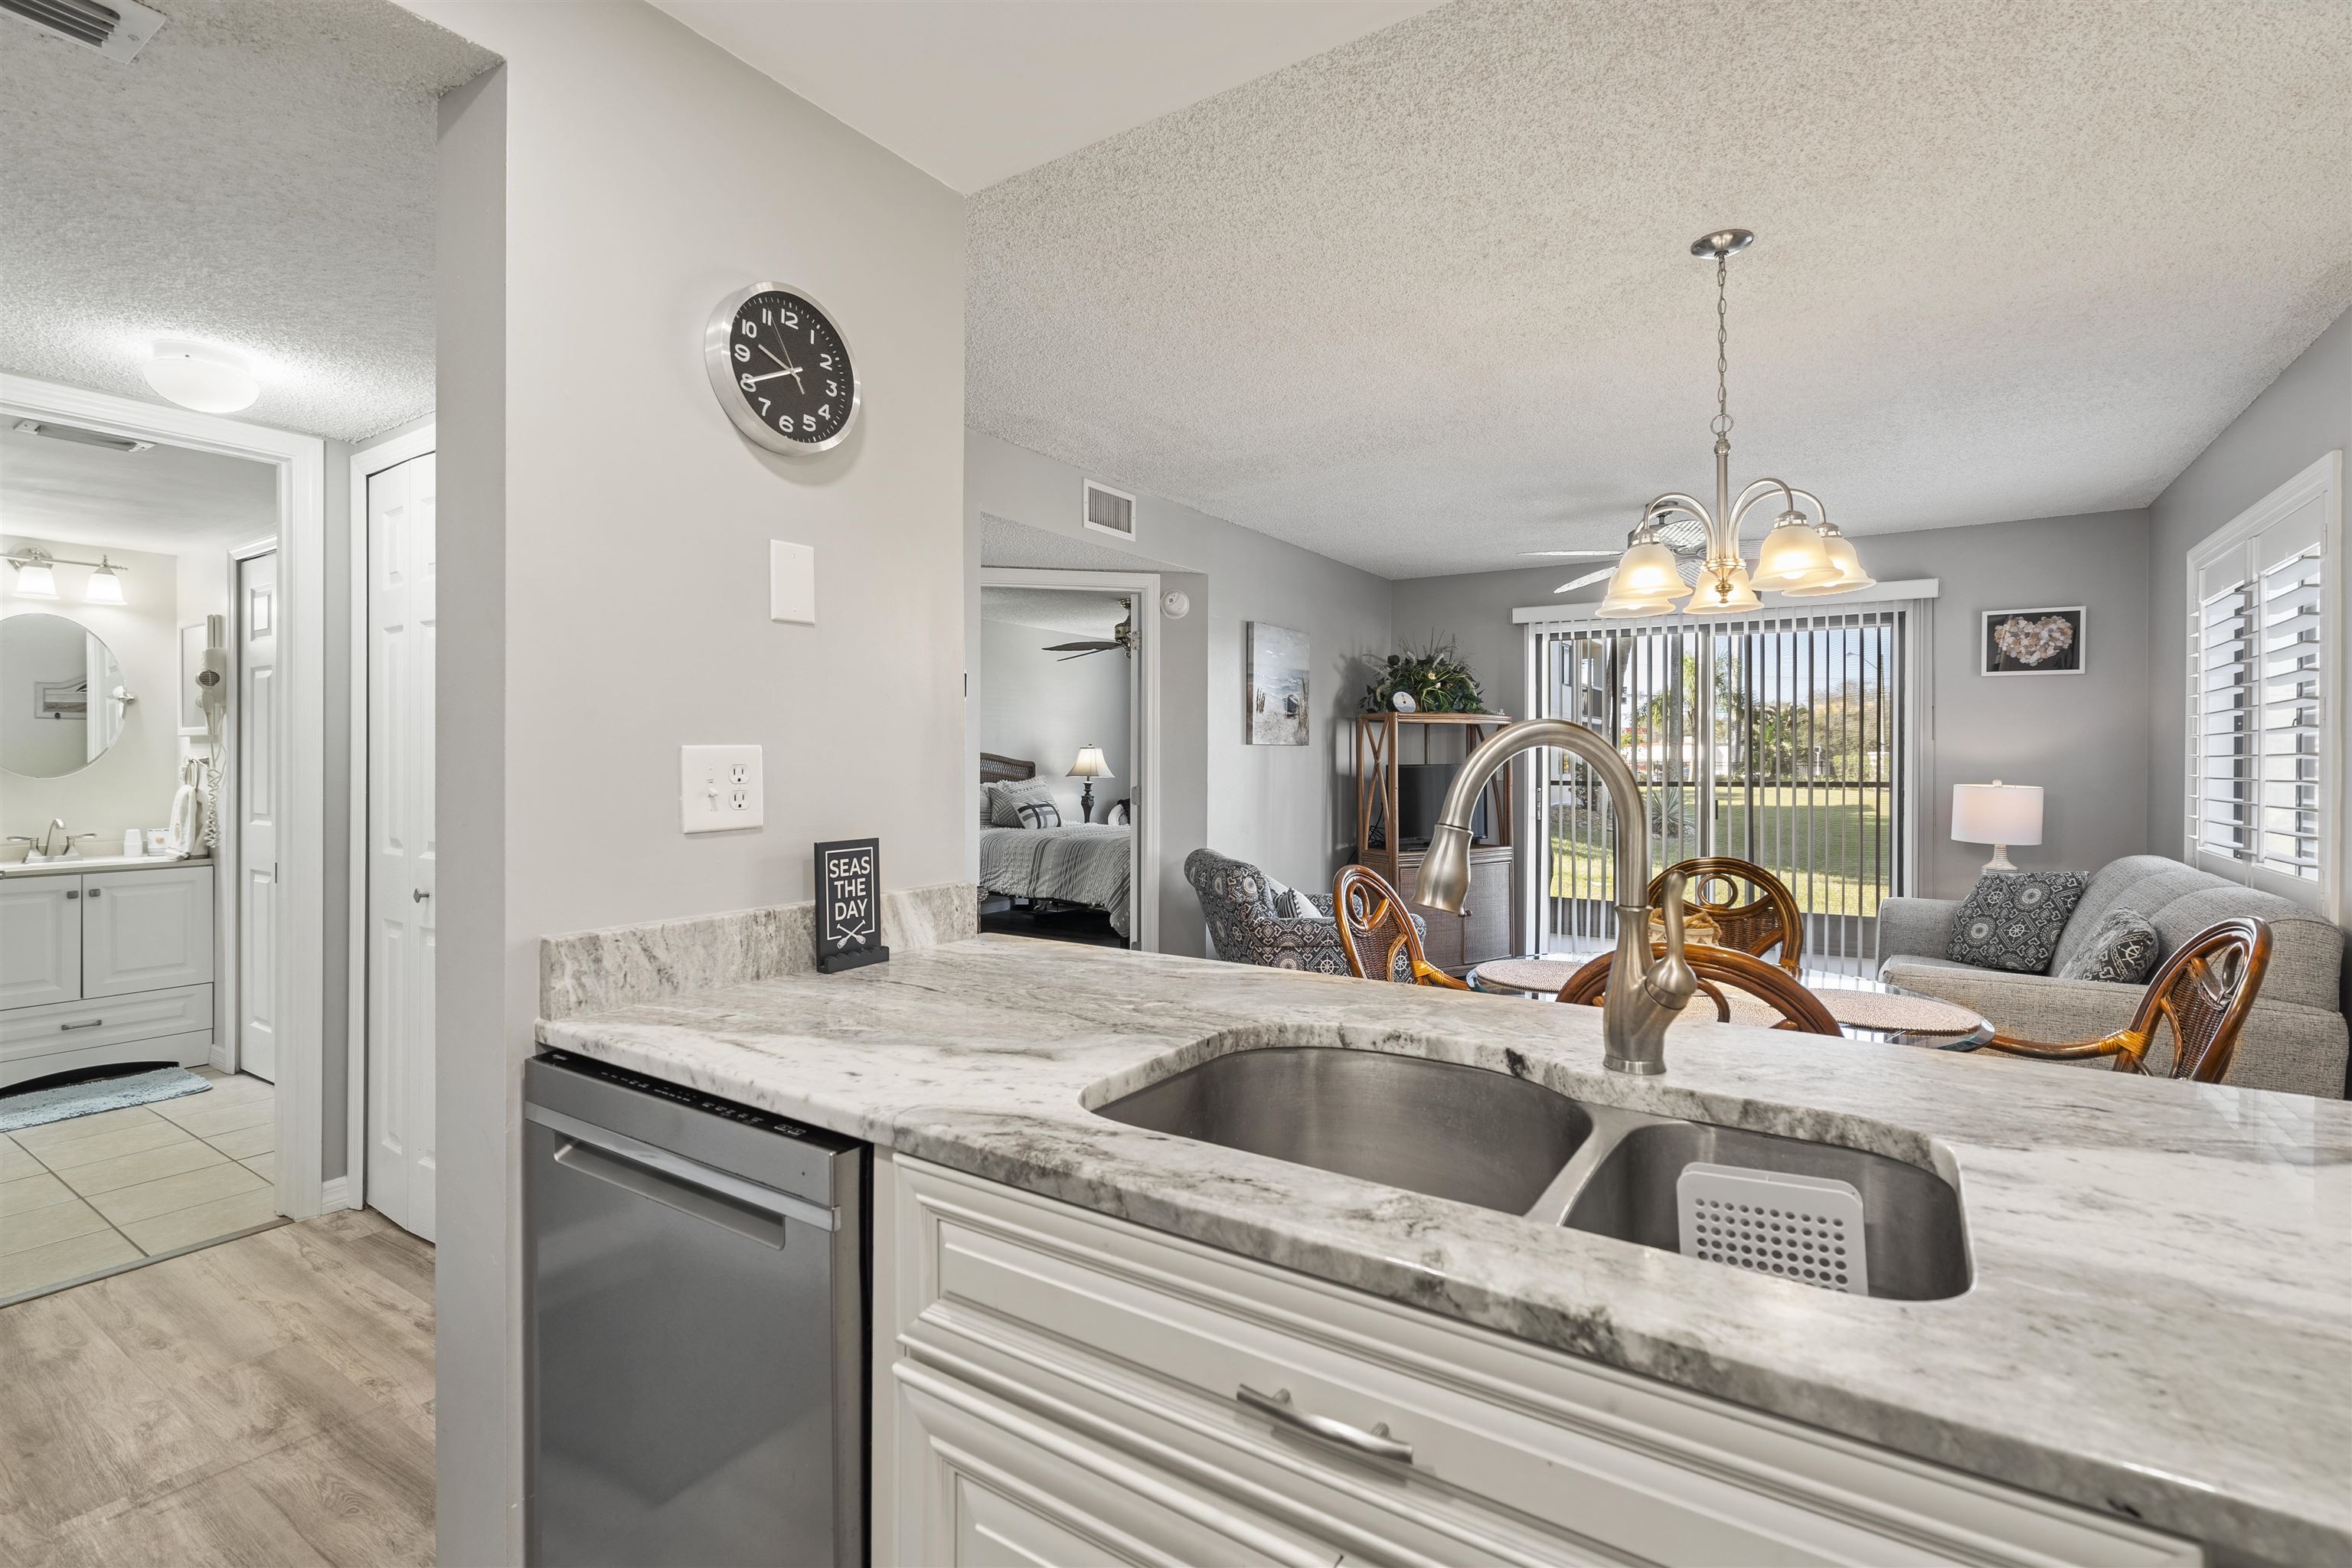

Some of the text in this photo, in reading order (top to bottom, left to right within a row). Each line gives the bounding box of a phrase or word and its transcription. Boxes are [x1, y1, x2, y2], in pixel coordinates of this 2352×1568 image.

[763, 308, 772, 326] 11
[781, 309, 799, 329] 12
[742, 318, 757, 338] 10
[810, 329, 815, 345] 1
[734, 344, 751, 362] 9
[820, 353, 832, 371] 2
[740, 373, 756, 392] 8
[825, 380, 838, 397] 3
[758, 397, 771, 416] 7
[818, 403, 831, 420] 4
[779, 415, 794, 433] 6
[802, 414, 816, 432] 5
[829, 856, 870, 878] SEAS
[834, 878, 866, 899] THE
[835, 898, 867, 921] DAY
